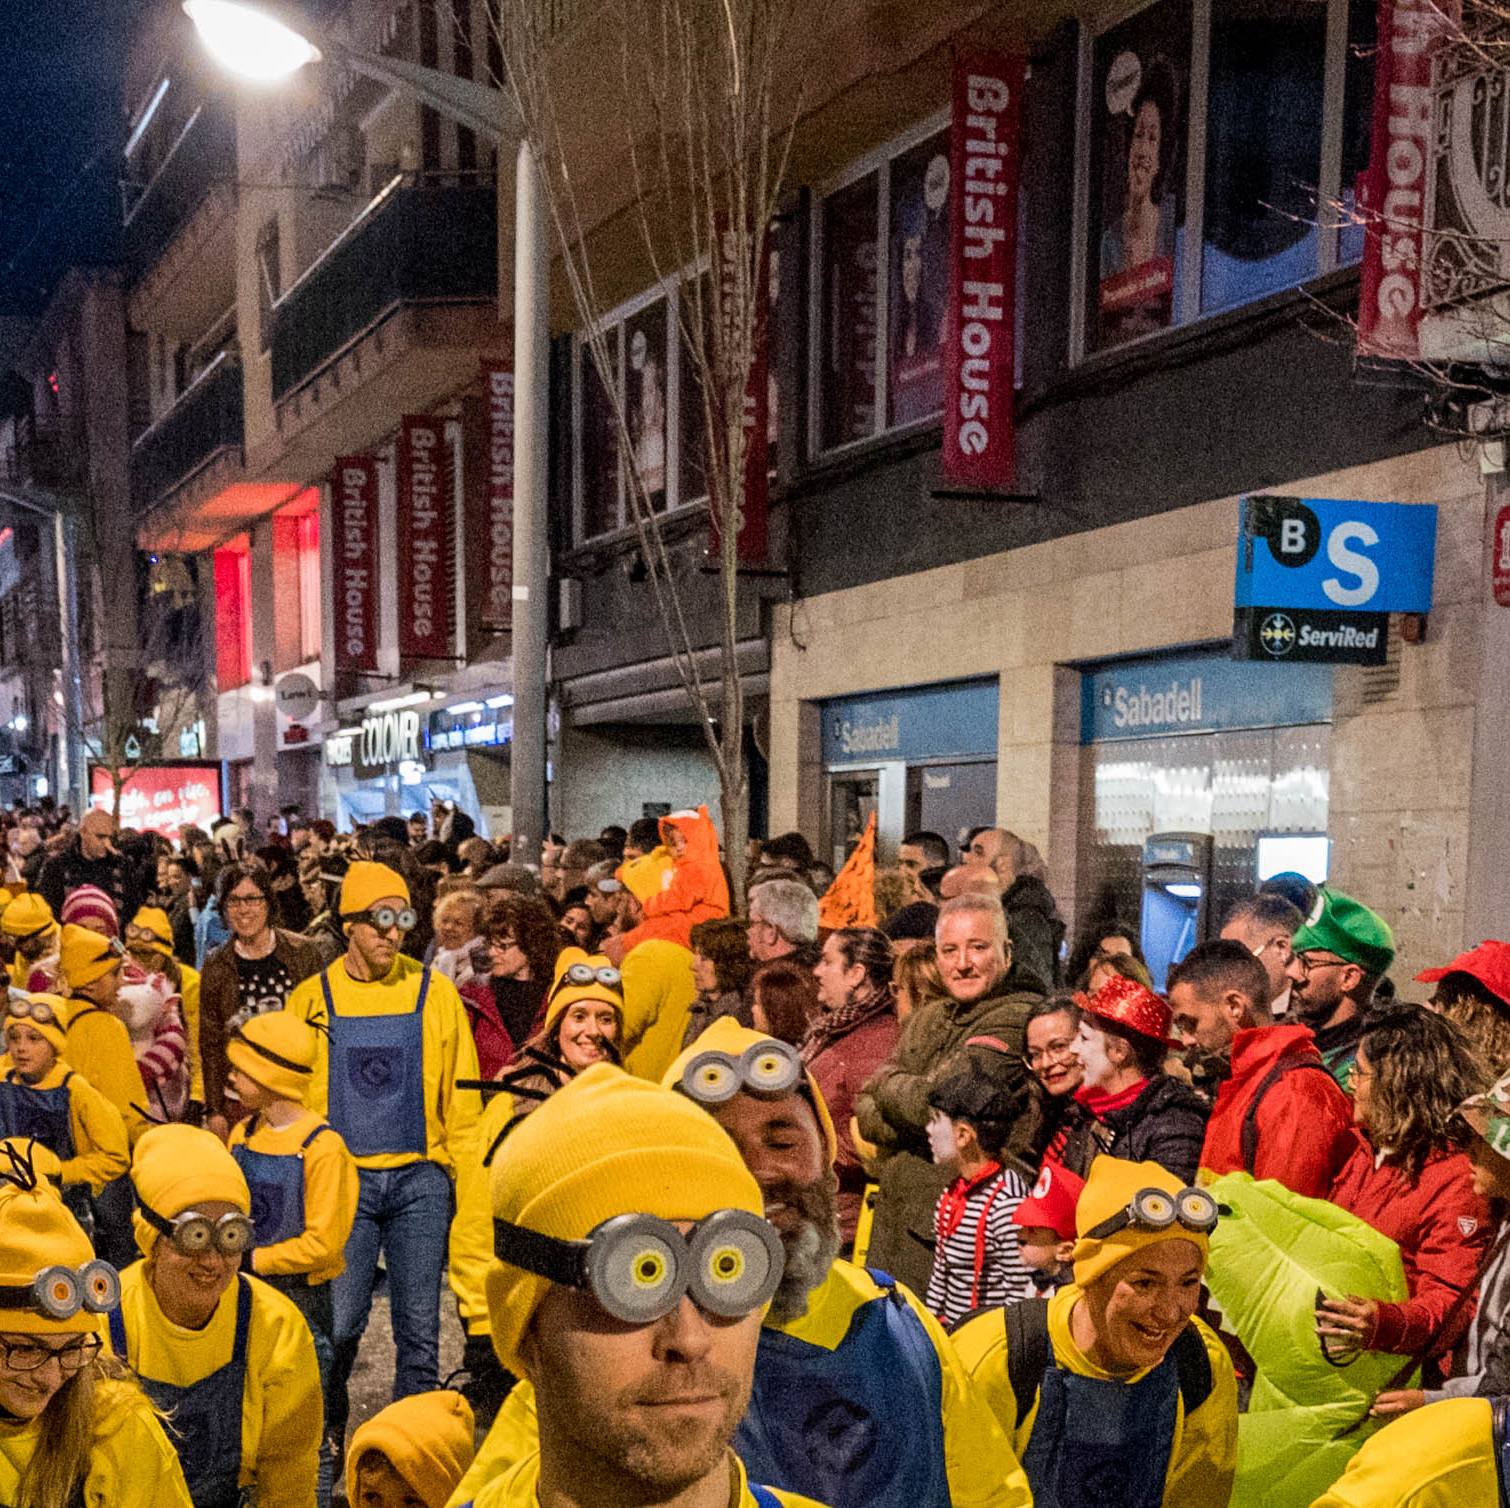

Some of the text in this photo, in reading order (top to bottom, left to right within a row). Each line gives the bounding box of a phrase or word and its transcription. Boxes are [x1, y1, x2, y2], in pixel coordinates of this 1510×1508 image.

[958, 74, 1010, 456] British House
[342, 467, 368, 657] British House
[410, 427, 439, 638] British House
[1280, 518, 1380, 607] B S
[1298, 625, 1379, 650] ServiRed
[842, 714, 899, 754] Sabadell
[1114, 678, 1203, 729] Sabadell
